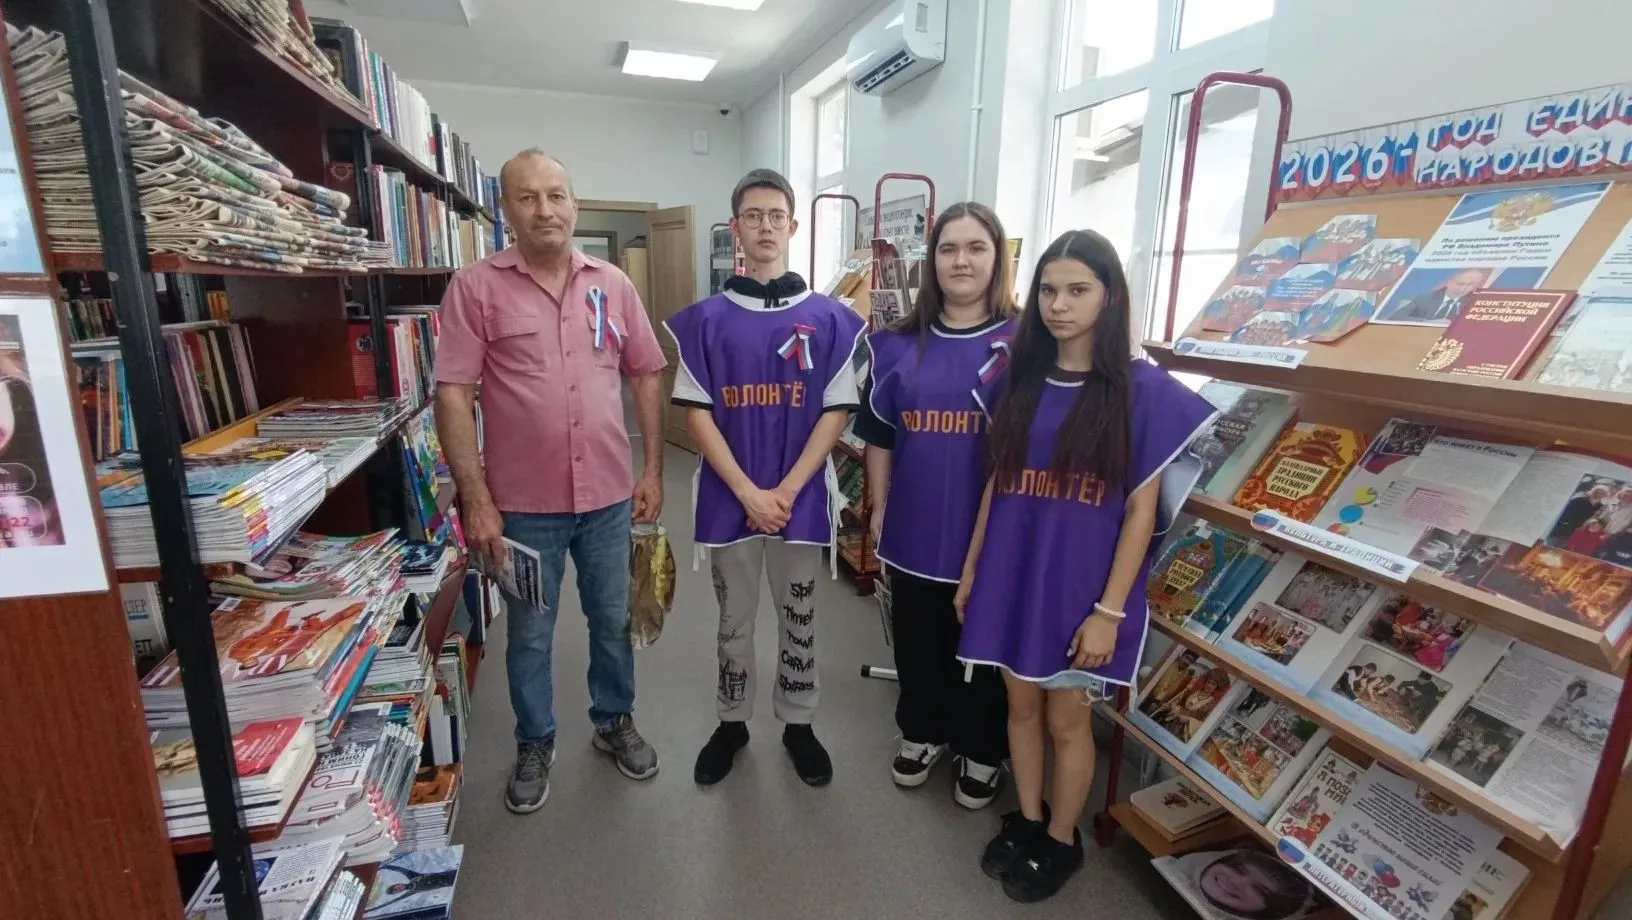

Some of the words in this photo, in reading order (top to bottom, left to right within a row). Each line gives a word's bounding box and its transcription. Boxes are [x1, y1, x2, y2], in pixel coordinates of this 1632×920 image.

[1430, 112, 1500, 148] ГОД
[1416, 138, 1604, 184] НАРОДОВ
[1469, 306, 1540, 316] РОССИЙСКОЙ
[1475, 300, 1551, 309] КОНСТИТУЦИЯ
[1465, 313, 1528, 323] ФЕДЕРАЦИИ
[901, 409, 986, 434] ВОЛОНТ
